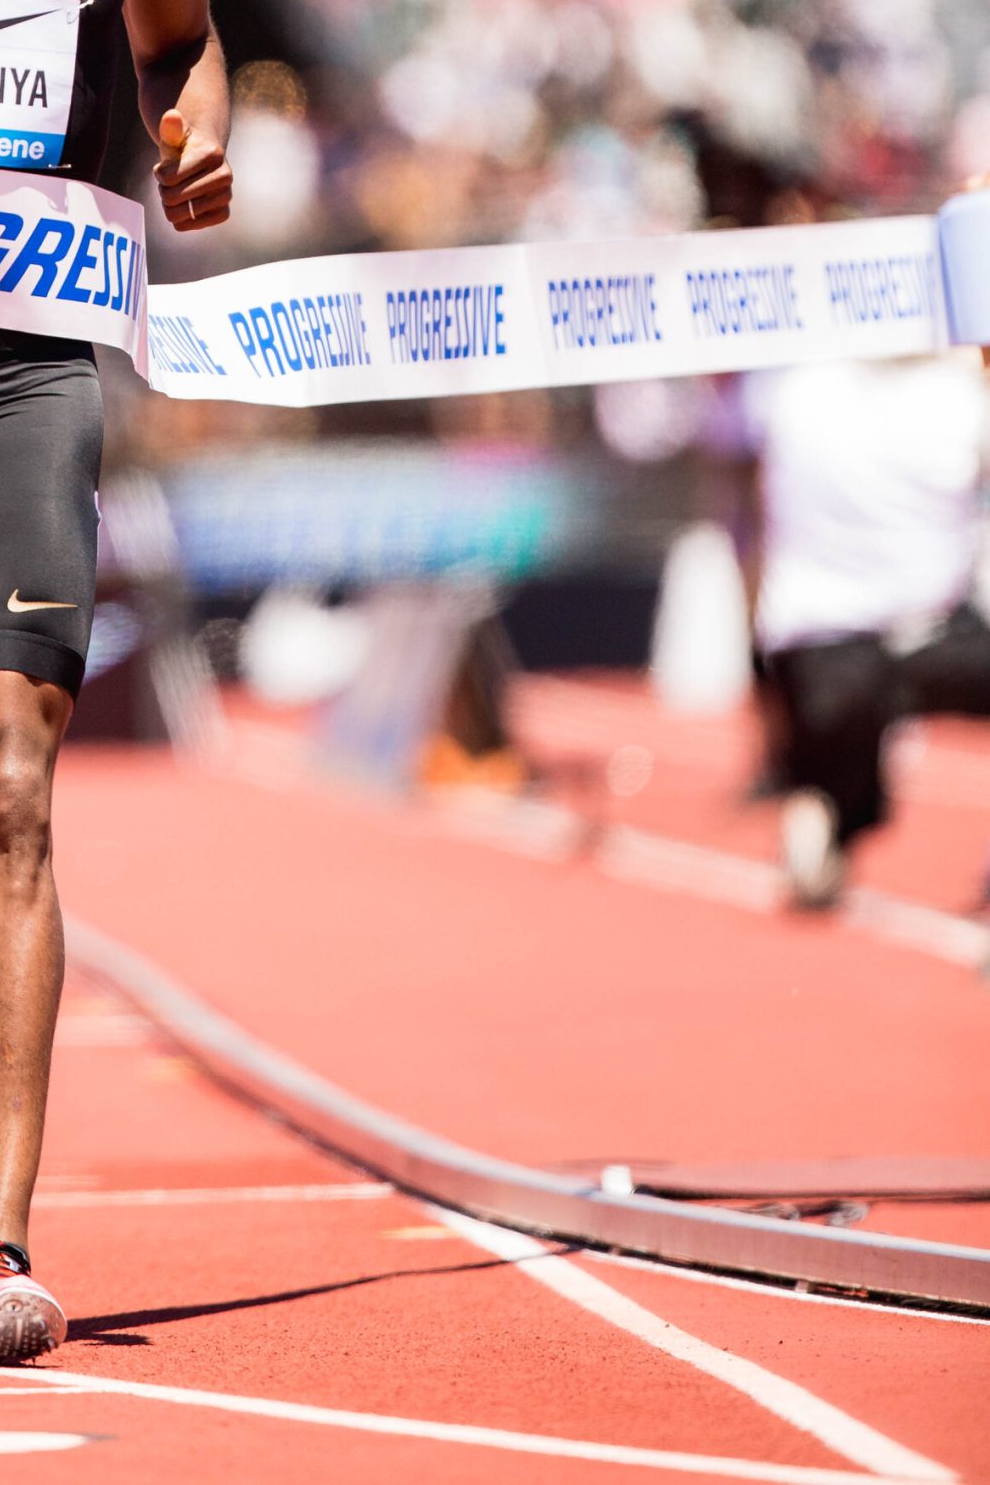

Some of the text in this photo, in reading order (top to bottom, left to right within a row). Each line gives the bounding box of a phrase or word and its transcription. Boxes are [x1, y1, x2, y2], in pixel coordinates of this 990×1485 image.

[228, 292, 371, 378] PROGRESSIVE
[386, 285, 506, 363] PROGRESSIVE
[547, 272, 662, 349] PROGRESSIVE
[684, 264, 802, 338] PROGRESSIVE
